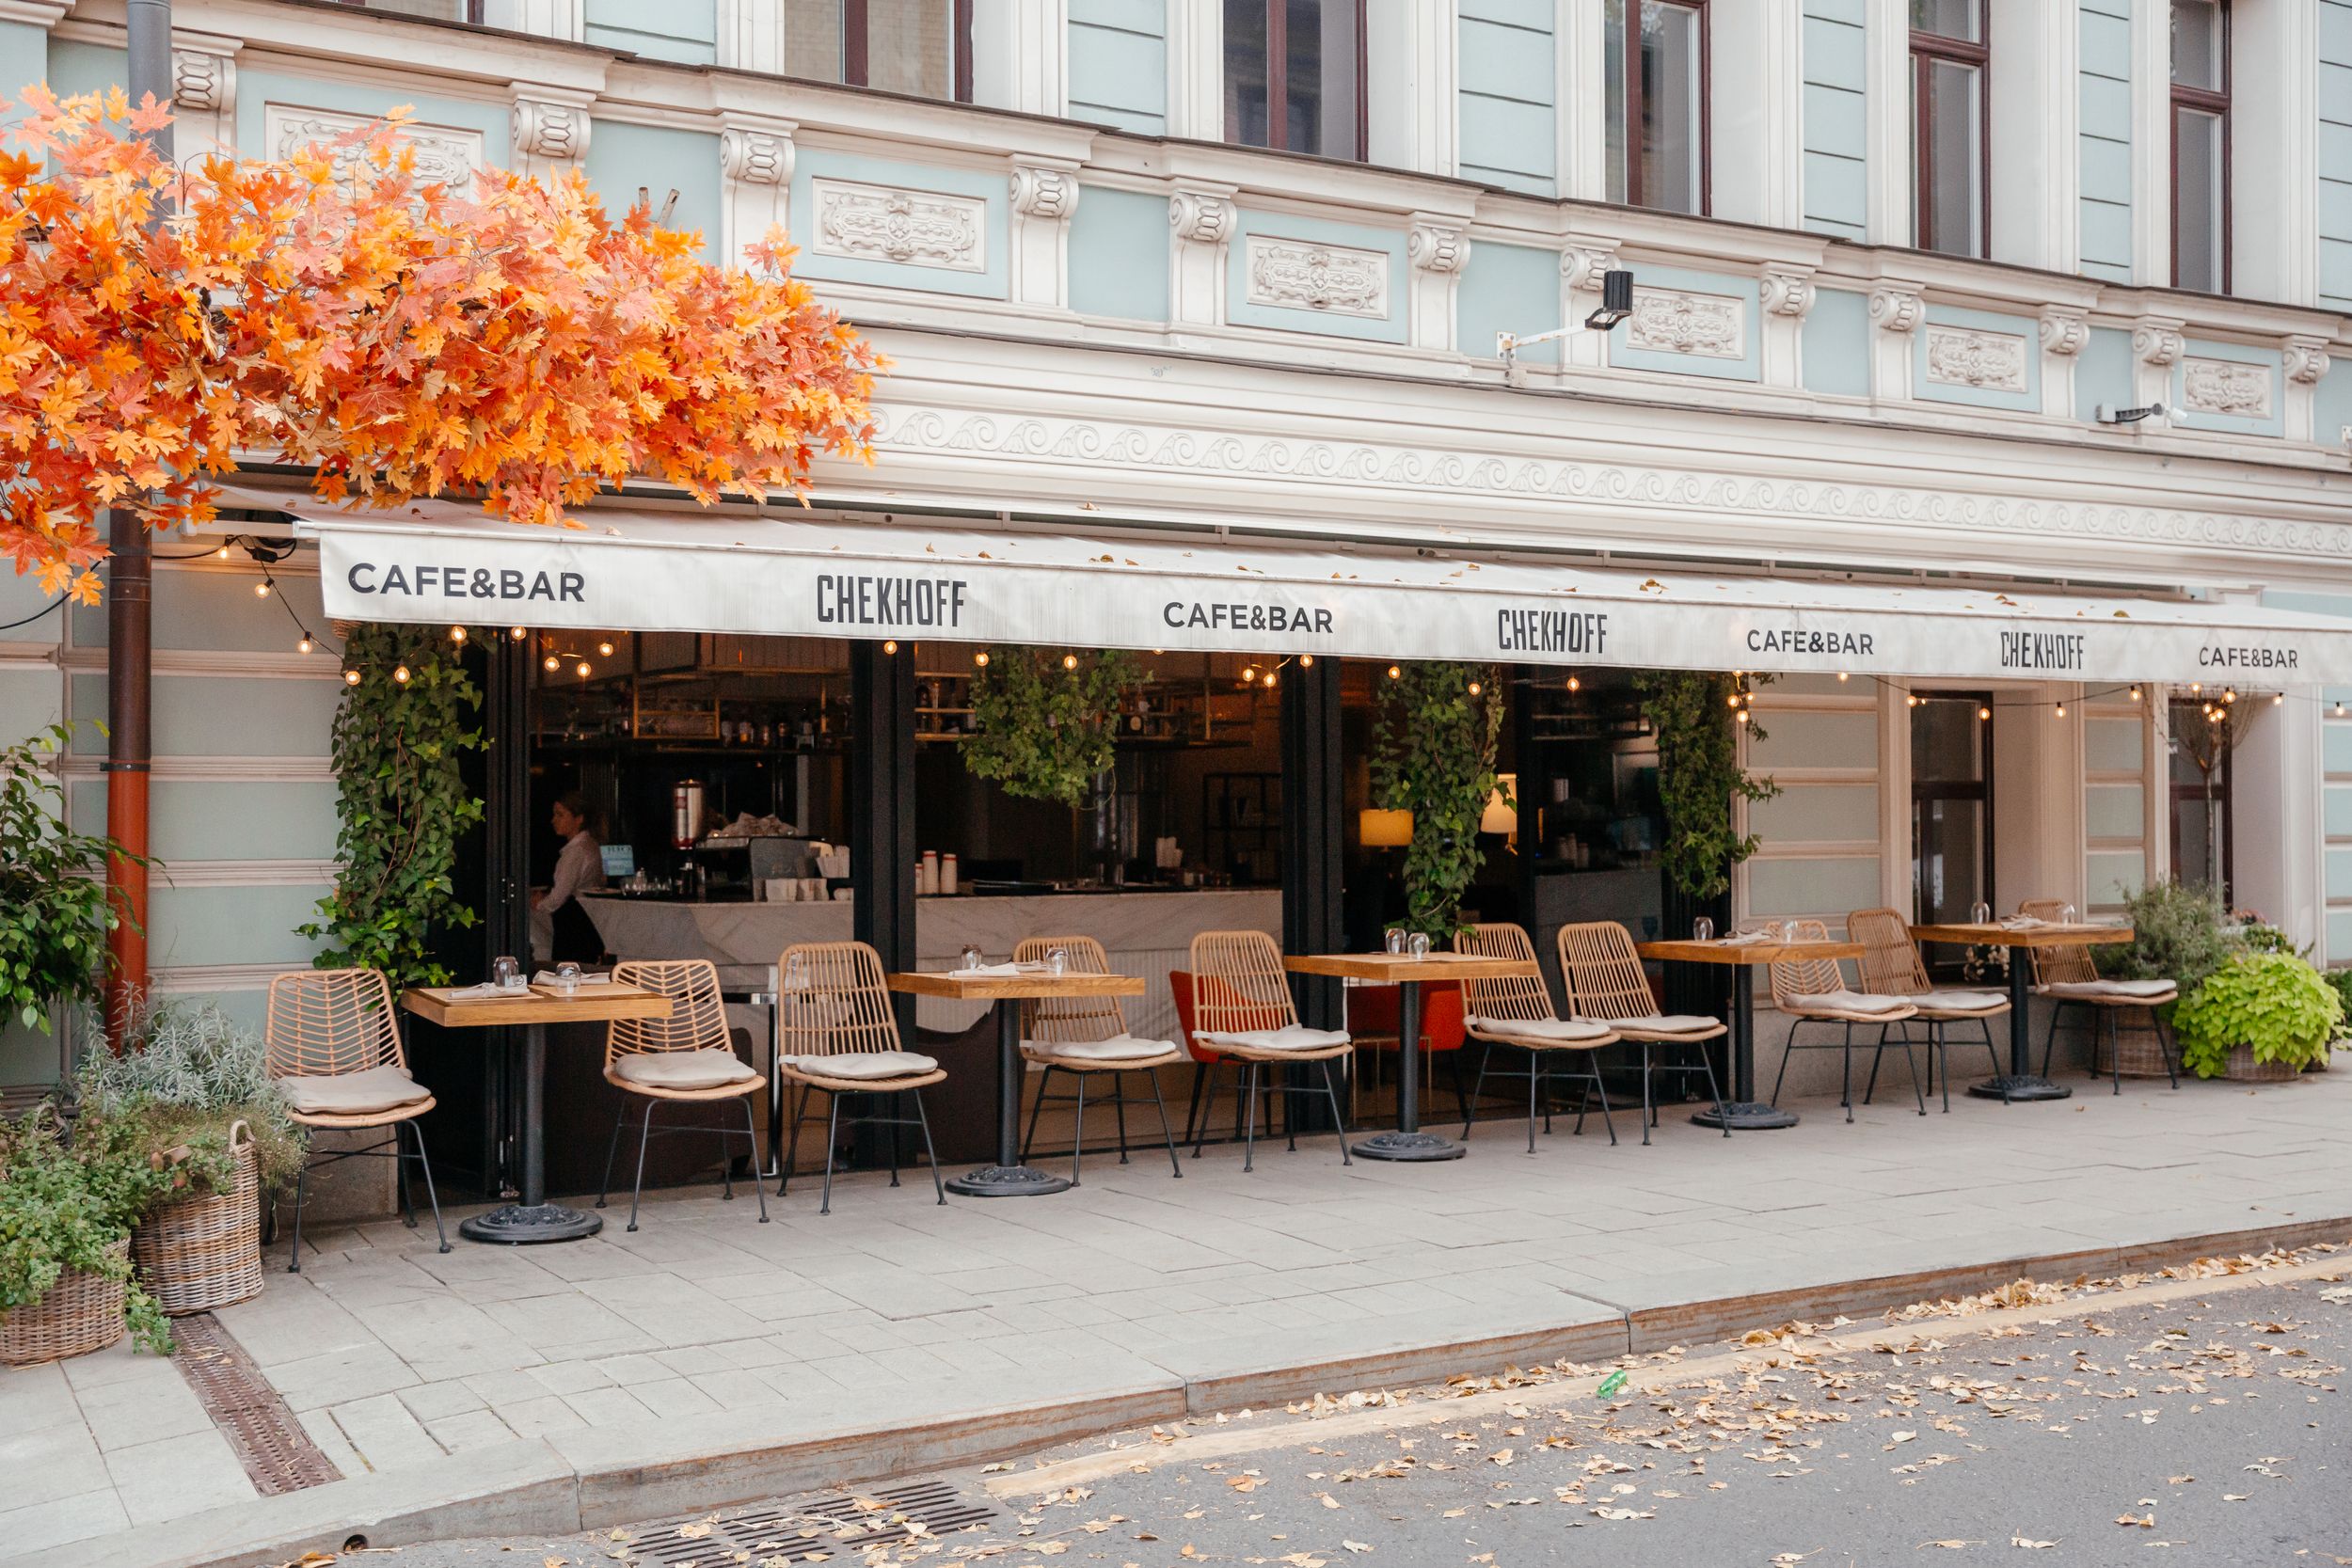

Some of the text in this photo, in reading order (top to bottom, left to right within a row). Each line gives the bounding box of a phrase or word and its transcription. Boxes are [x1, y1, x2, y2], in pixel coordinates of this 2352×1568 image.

[347, 562, 585, 603] CAFE&BAR
[817, 575, 967, 628] CHEKHOFF
[1163, 601, 1333, 634] CAFE&BAR
[1498, 609, 1607, 654] CHEKHOFF
[1747, 629, 1874, 656] CAFE&BAR
[2000, 631, 2084, 671] CHEKHOFF
[2199, 646, 2297, 669] CAFE&BAR
